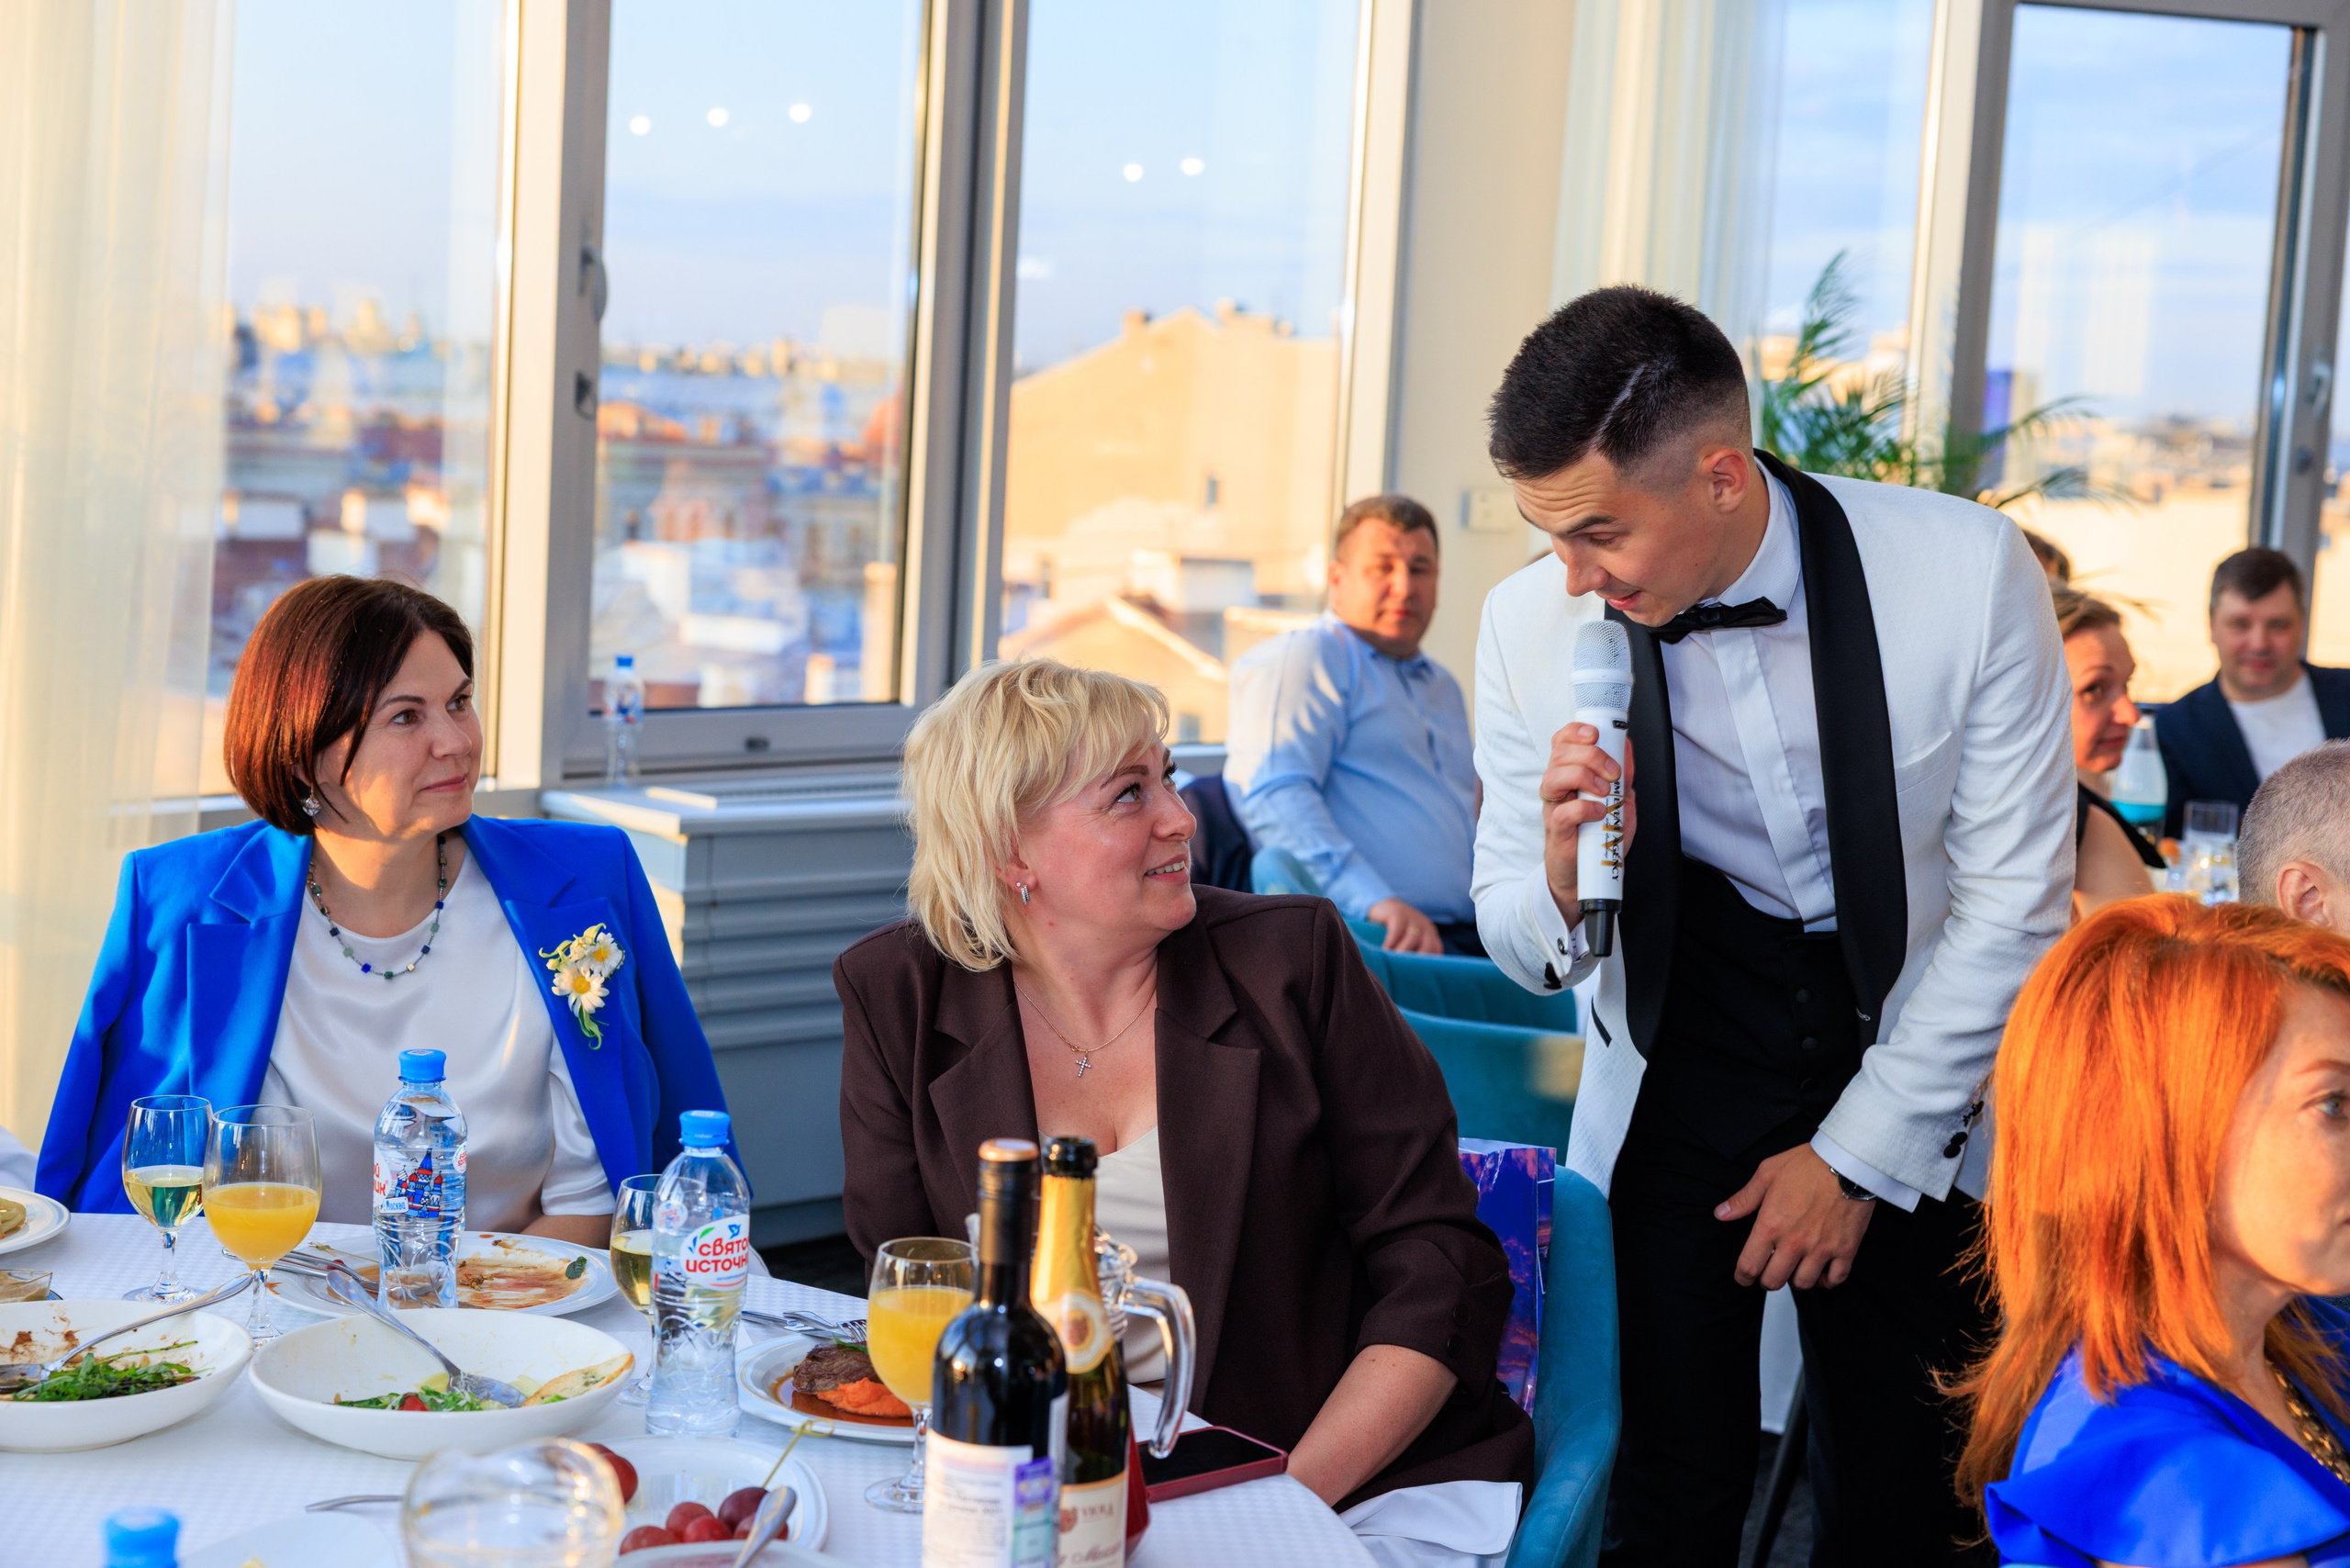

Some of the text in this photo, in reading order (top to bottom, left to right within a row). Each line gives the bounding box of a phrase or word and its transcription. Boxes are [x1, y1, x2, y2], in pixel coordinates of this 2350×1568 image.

[1611, 834, 1619, 881] AGENCY
[386, 1200, 406, 1210] Москва
[698, 1237, 749, 1258] свято
[685, 1251, 749, 1273] источн
